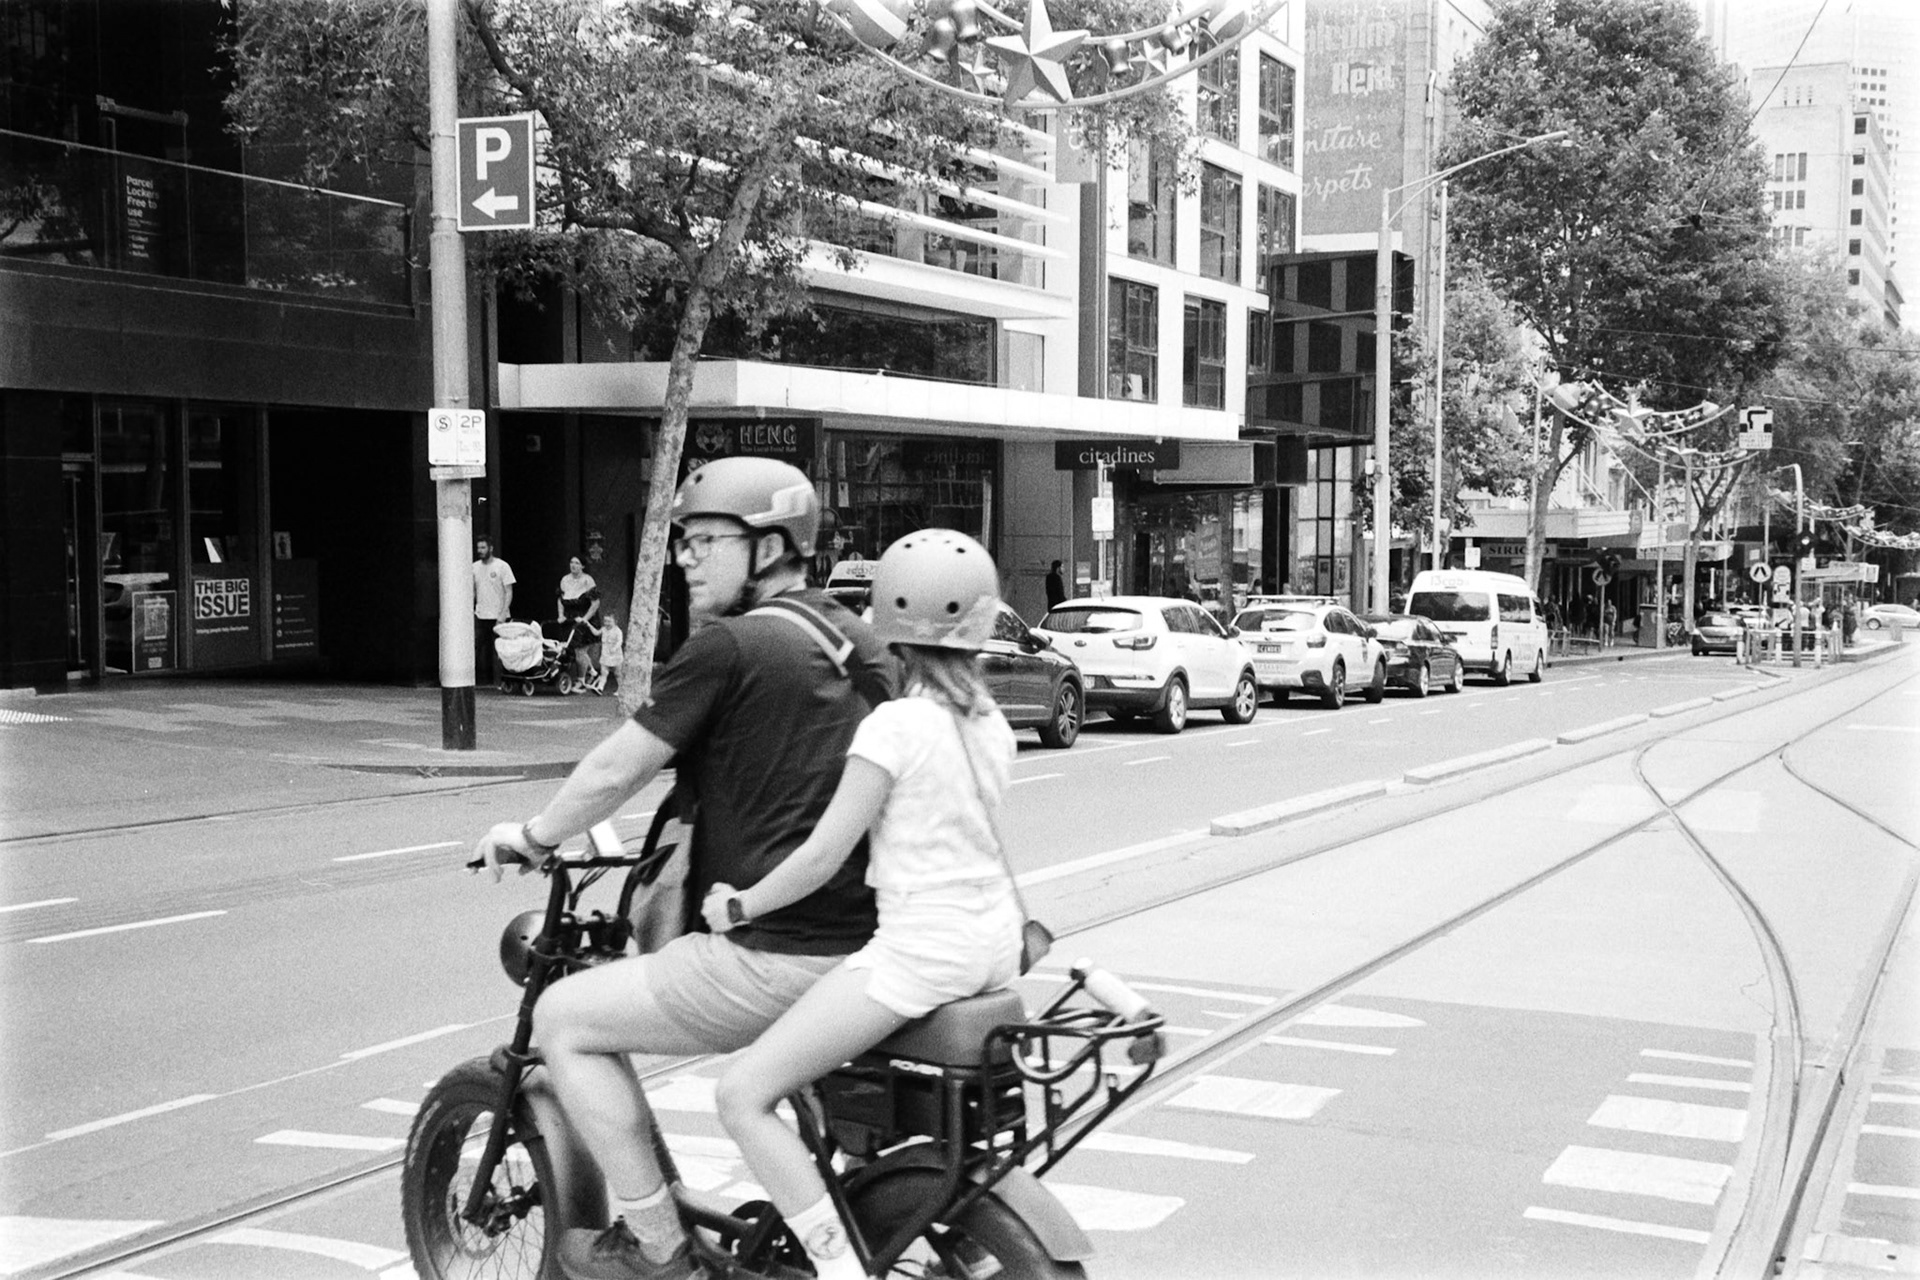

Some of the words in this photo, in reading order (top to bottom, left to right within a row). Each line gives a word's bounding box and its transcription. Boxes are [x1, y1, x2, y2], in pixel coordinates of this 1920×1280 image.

[475, 127, 512, 181] P
[126, 175, 153, 189] Parcel
[127, 196, 146, 208] Free
[148, 200, 158, 209] to
[127, 208, 143, 217] use
[460, 415, 482, 428] 2P
[740, 424, 797, 445] HENG
[1079, 446, 1155, 464] citadines
[196, 582, 223, 594] THE
[225, 580, 248, 592] BIG
[196, 594, 249, 617] ISSUE
